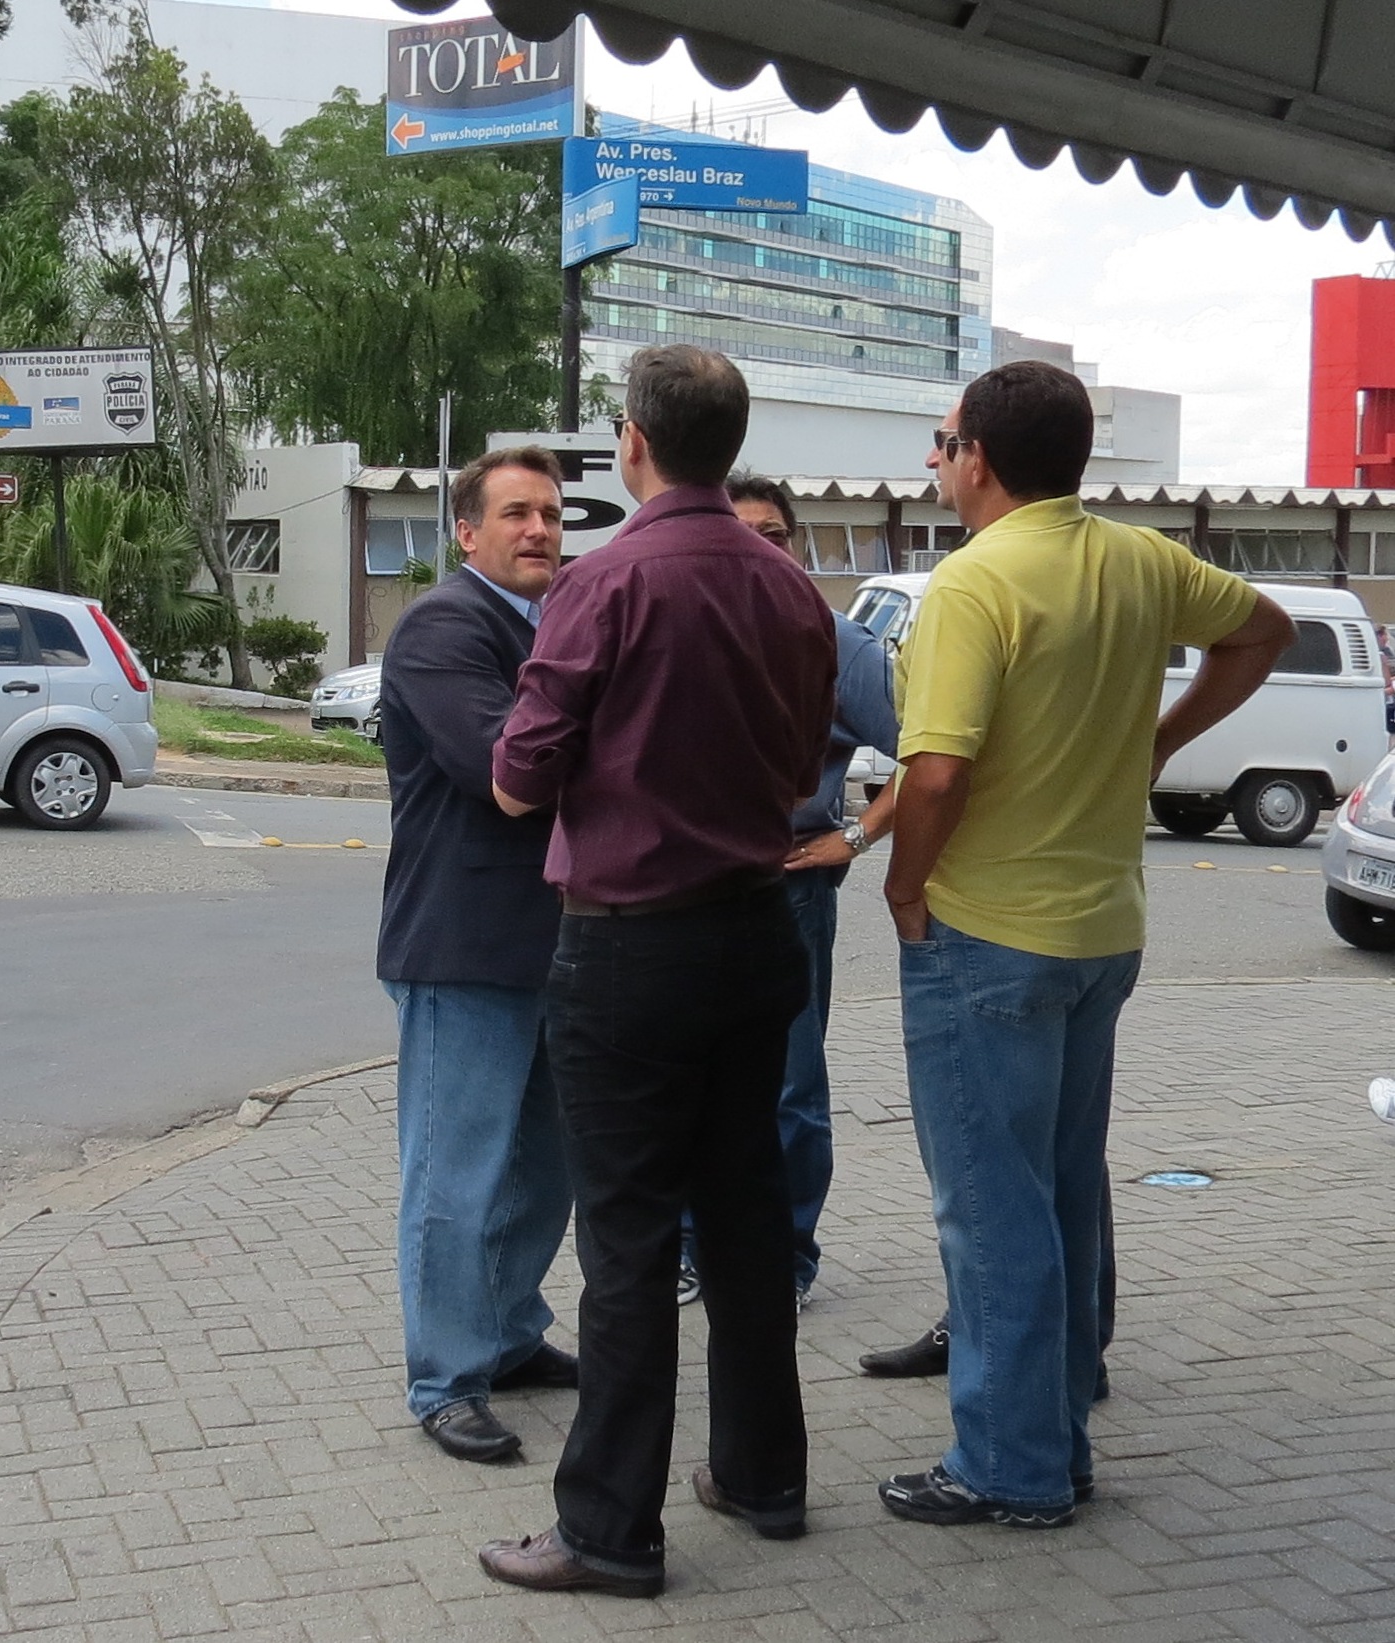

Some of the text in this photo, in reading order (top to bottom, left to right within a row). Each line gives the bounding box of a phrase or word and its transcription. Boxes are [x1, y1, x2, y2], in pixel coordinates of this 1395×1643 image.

[398, 31, 560, 97] TOTAL
[430, 119, 559, 142] www.shoppingtotal.net
[596, 141, 678, 161] Av. Pres.
[596, 163, 744, 186] Wenceslau Braz
[736, 196, 762, 208] Novo
[5, 356, 63, 366] INTEGRADO
[65, 355, 77, 364] DE
[78, 352, 151, 364] ATENDIMENTO
[27, 368, 41, 377] AO
[107, 394, 145, 408] POLÍCIA
